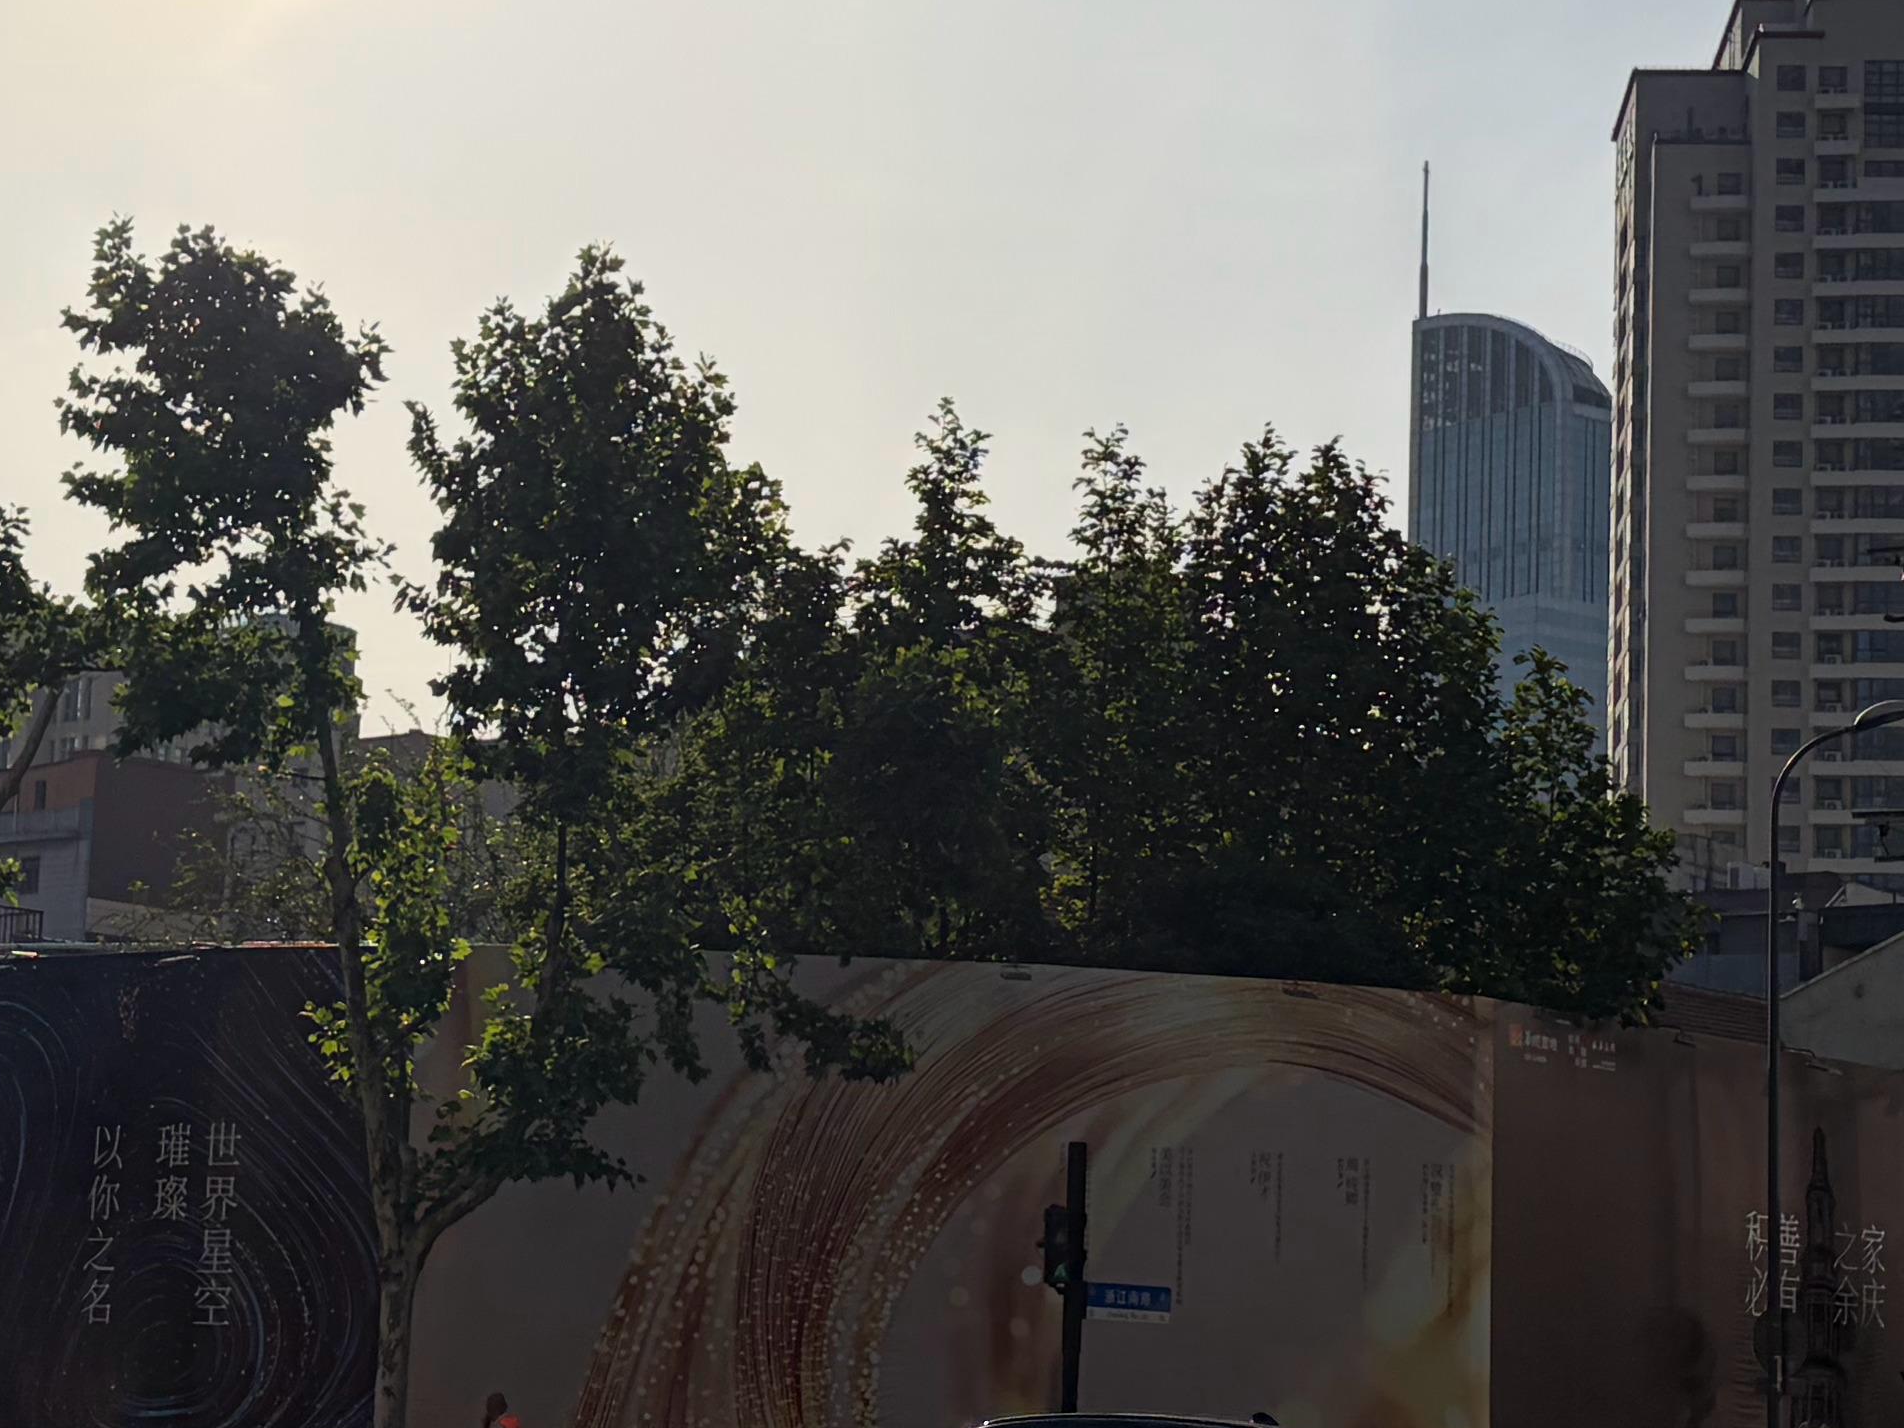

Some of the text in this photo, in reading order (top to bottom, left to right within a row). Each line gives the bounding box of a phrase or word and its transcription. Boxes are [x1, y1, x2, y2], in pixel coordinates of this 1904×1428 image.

[80, 1124, 123, 1325] 以你之名
[152, 1122, 191, 1221] 璀璨
[192, 1120, 242, 1326] 世界星空
